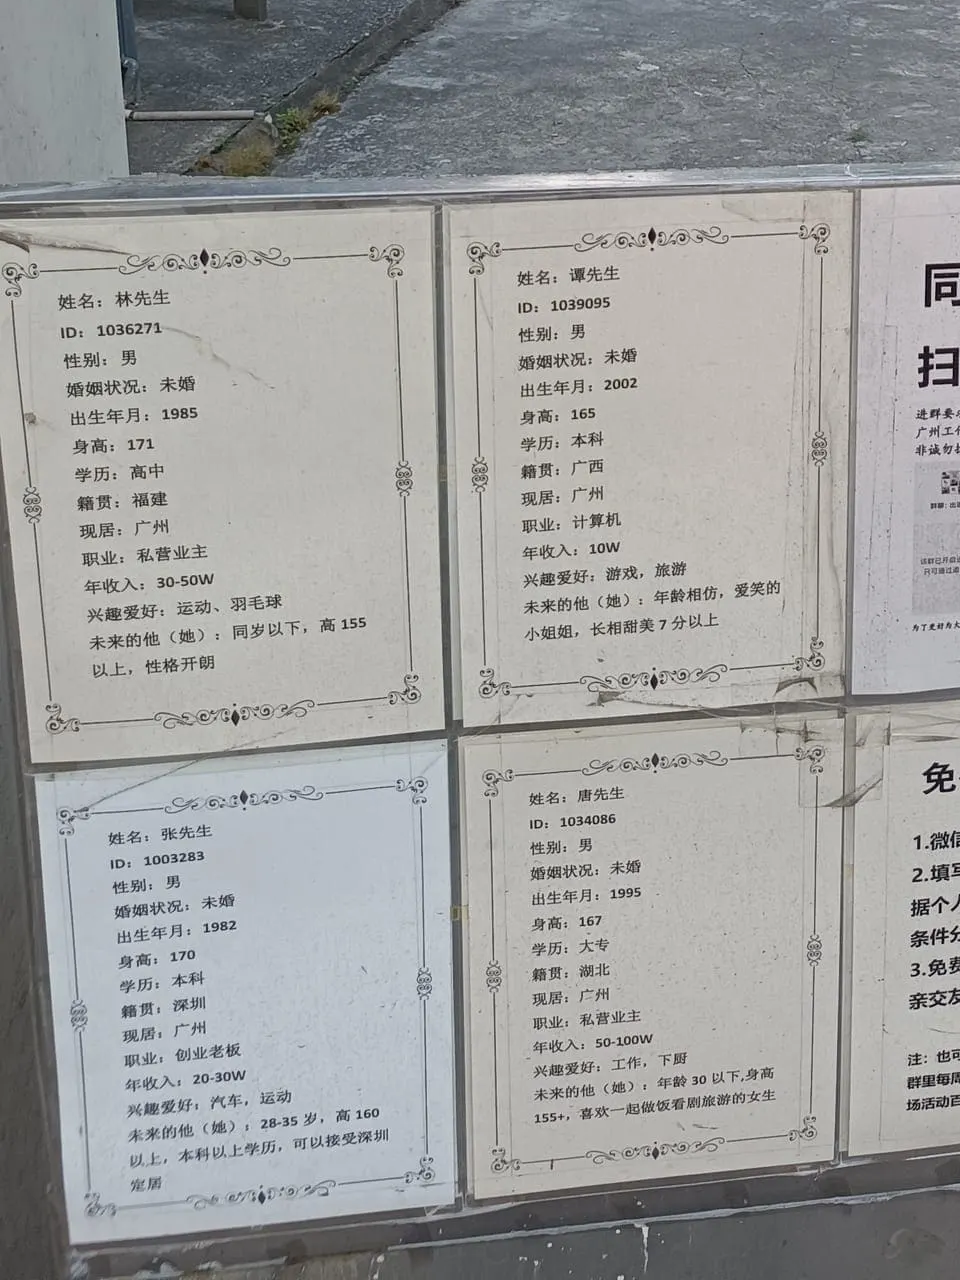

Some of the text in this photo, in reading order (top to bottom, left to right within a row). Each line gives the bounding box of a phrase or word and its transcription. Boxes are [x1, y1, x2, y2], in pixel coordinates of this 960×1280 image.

[517, 265, 620, 287] 姓名：谭先生
[57, 289, 171, 311] 姓名：林先生
[517, 296, 611, 314] ID：1039095
[60, 322, 162, 339] ID：1036271
[519, 348, 638, 371] 婚姻状况：未婚
[66, 375, 196, 398] 婚姻状况：未婚
[520, 377, 638, 398] 出生年月：2002
[70, 406, 198, 426] 出生年月：1985
[520, 407, 596, 426] 身高：165
[72, 438, 155, 455] 身高：171
[520, 431, 604, 452] 学历：本科
[75, 463, 165, 483] 学历：高中
[521, 459, 604, 480] 籍贯：广西
[77, 491, 168, 512] 籍贯：福建
[521, 486, 604, 507] 现居：广州
[79, 519, 169, 540] 现居：广州
[522, 511, 622, 533] 职业：计算机
[82, 543, 208, 567] 职业：私营业主
[522, 541, 621, 561] 年收入：10W
[84, 573, 214, 595] 年收入：30-50W
[529, 786, 625, 807] 姓名：唐先生
[529, 813, 617, 830] ID：1034086
[108, 824, 213, 846] 姓名：张先生
[110, 851, 205, 870] ID：1003283
[530, 859, 642, 881] 婚姻状况：未婚
[114, 893, 235, 920] 婚姻状况：未婚
[531, 887, 642, 907] 出生年月：1995
[117, 920, 237, 945] 出生年月：1982
[531, 915, 602, 932] 身高：167
[532, 938, 610, 956] 学历：大专
[118, 949, 196, 970] 身高：170
[119, 970, 205, 994] 学历：本科
[532, 963, 610, 982] 籍贯：湖北
[532, 987, 610, 1006] 现居：广州
[121, 996, 206, 1020] 籍贯：深圳
[533, 1009, 642, 1030] 职业：私营业主
[122, 1021, 207, 1043] 现居：广州
[533, 1033, 653, 1054] 年收入：50-100W
[124, 1042, 242, 1068] 职业：创业老板
[125, 1070, 246, 1092] 年收入：20-30W
[130, 1175, 162, 1193] 定居
